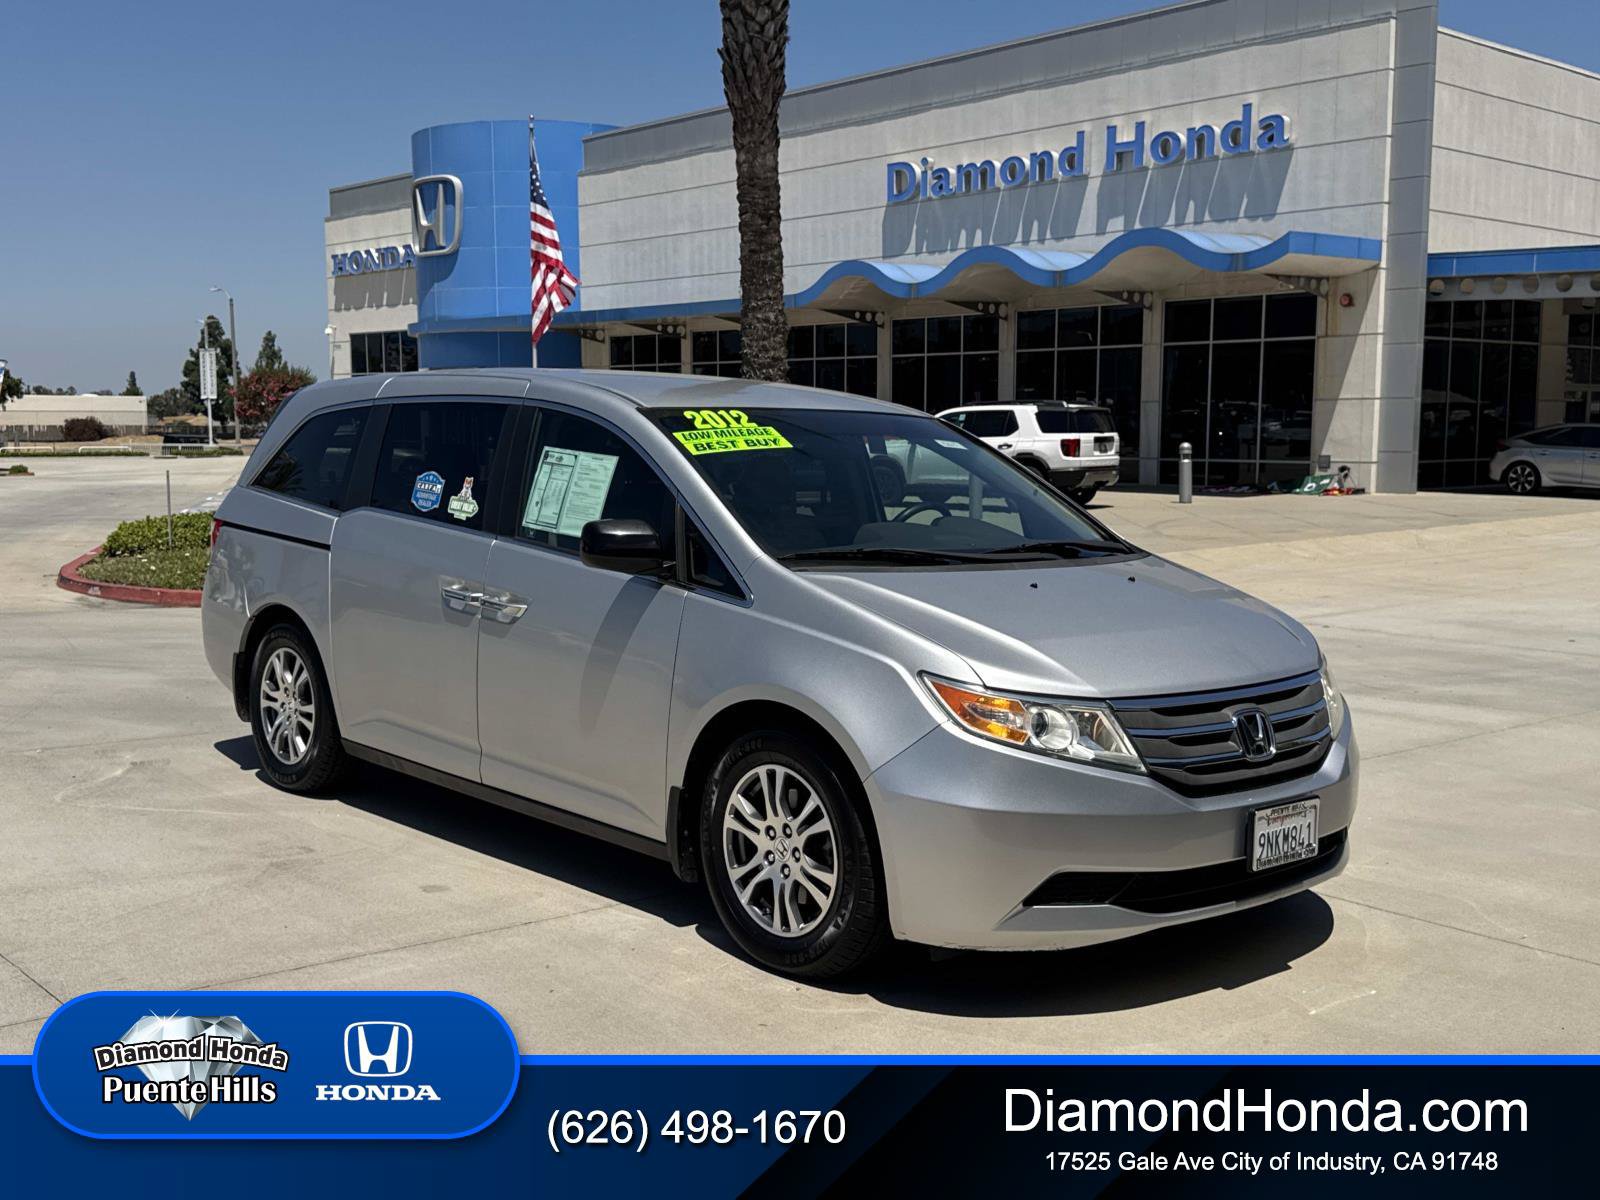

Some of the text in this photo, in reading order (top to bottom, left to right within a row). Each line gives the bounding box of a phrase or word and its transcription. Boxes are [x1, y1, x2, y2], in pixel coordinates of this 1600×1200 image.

[886, 103, 1291, 203] Diamond Honda
[331, 243, 417, 276] HONDA
[683, 410, 758, 429] 2012
[681, 427, 773, 441] LOW MILEAGE
[693, 438, 779, 452] BEST BUY
[1258, 821, 1312, 859] 9NKM841
